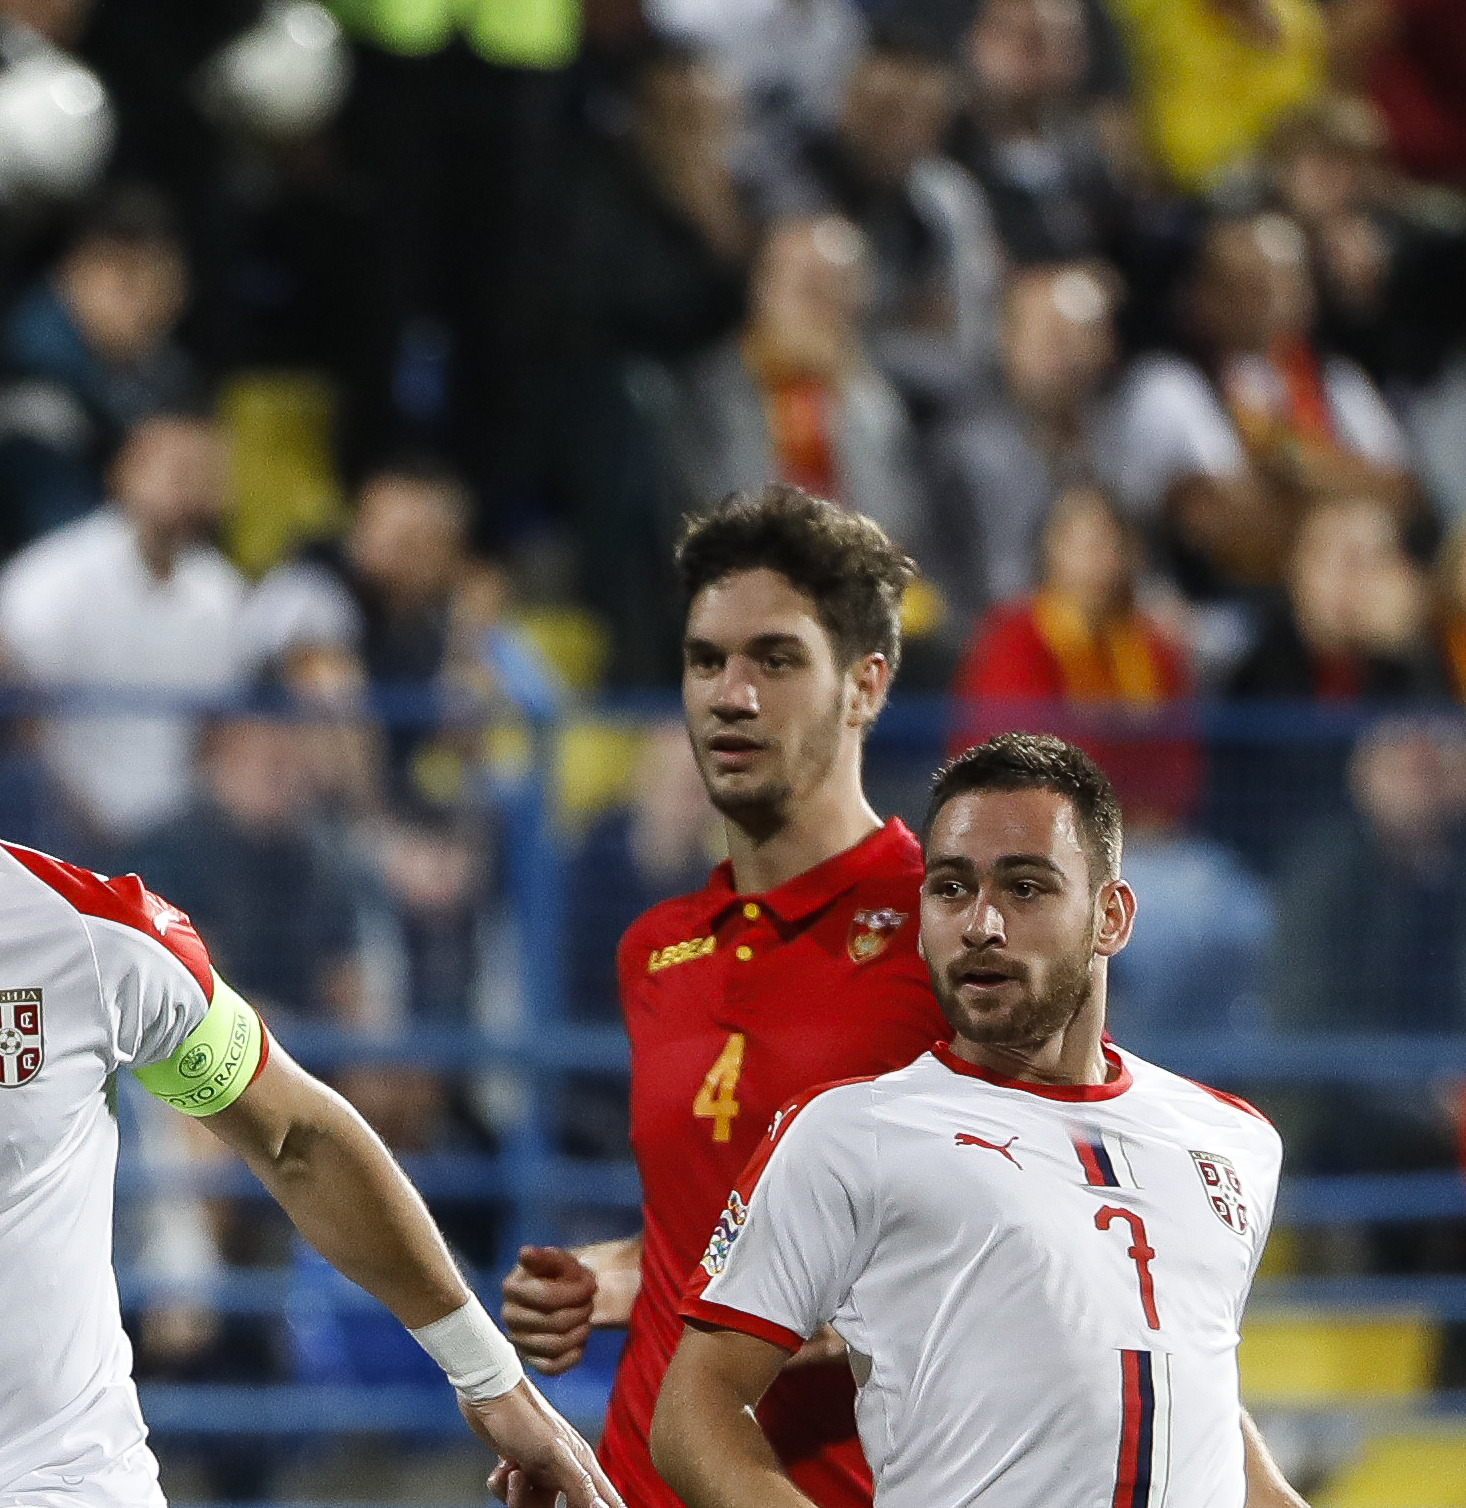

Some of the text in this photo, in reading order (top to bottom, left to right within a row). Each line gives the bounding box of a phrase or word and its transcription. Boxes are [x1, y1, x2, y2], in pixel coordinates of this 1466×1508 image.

[185, 1014, 248, 1104] TO RACISM
[693, 1033, 745, 1142] 4
[1094, 1204, 1161, 1330] 7
